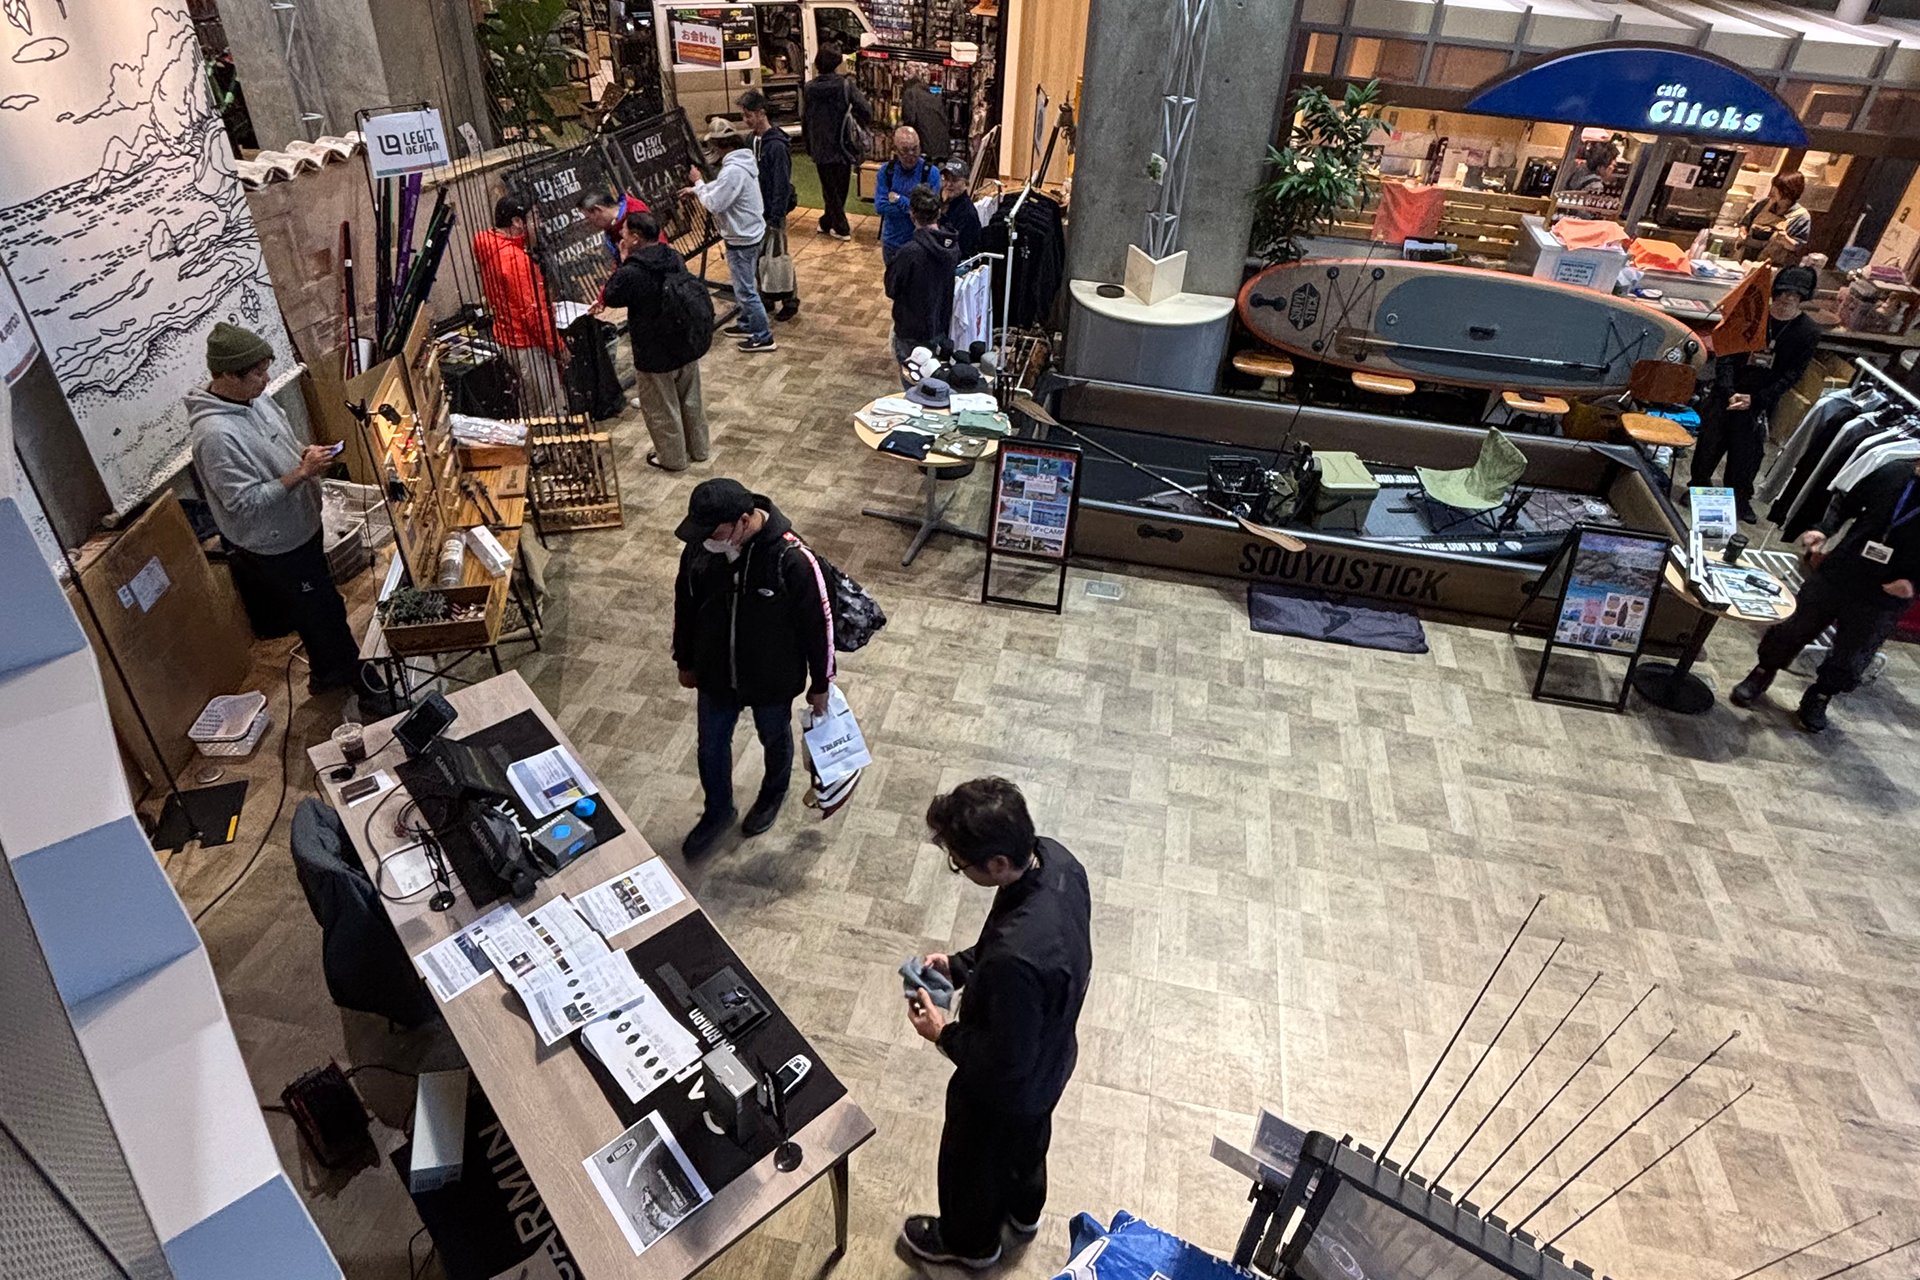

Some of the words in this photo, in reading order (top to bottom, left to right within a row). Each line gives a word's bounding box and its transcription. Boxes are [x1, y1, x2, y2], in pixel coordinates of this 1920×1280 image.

[1656, 84, 1687, 98] cafe
[1649, 100, 1763, 132] Clicks
[403, 128, 435, 146] LEGIT
[1238, 543, 1448, 600] SOUYUSTICK
[820, 733, 853, 753] TRUFFLE
[530, 812, 566, 838] GARMIN
